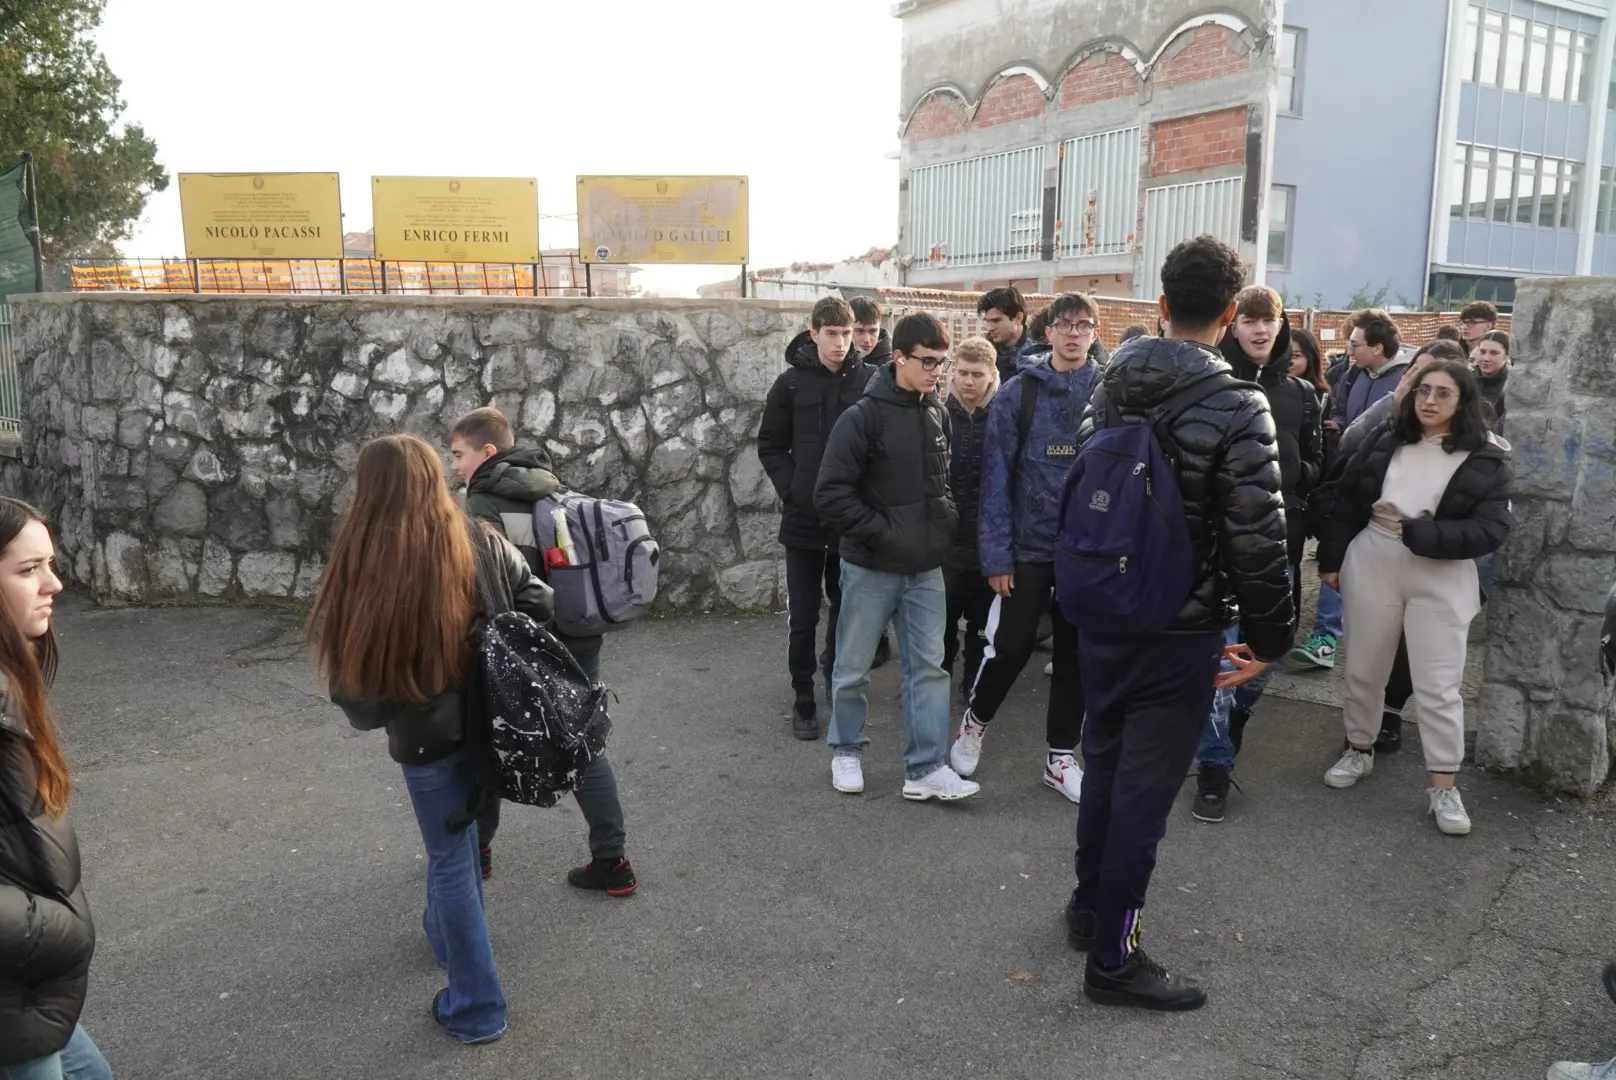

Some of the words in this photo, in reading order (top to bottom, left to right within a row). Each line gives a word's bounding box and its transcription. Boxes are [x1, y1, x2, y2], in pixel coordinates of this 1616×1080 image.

[205, 224, 259, 238] NICOLÒ
[264, 226, 321, 238] PACASSI
[404, 229, 458, 242] ENRICO
[464, 230, 509, 243] FERMI
